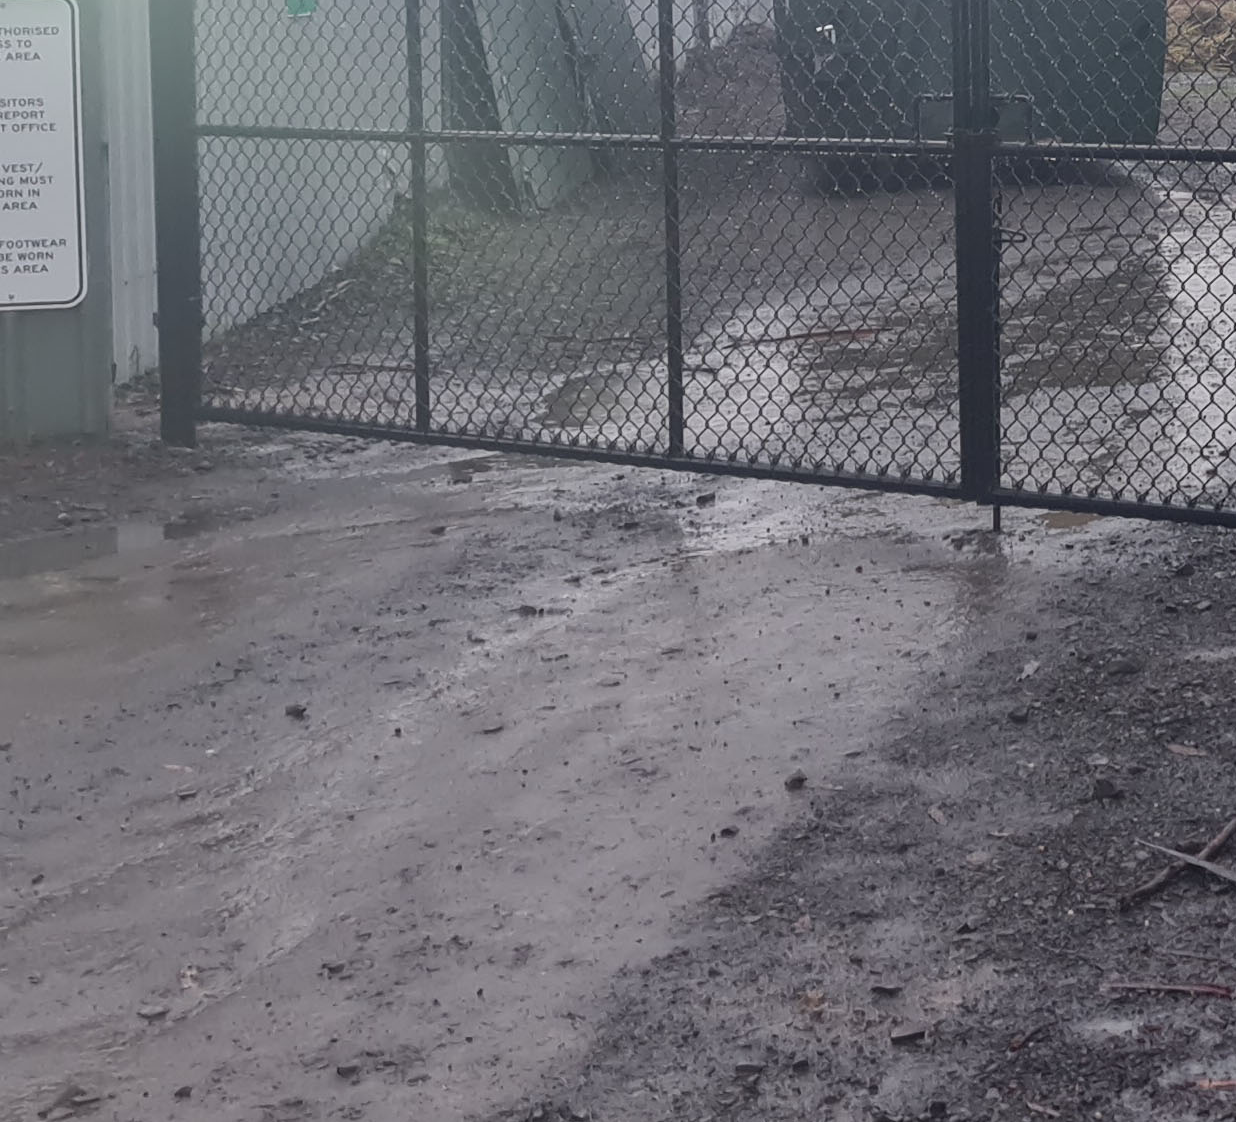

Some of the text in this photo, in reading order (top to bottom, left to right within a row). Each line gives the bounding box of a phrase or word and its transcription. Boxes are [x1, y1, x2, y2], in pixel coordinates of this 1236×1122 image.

[15, 39, 32, 48] TO
[5, 51, 41, 61] AREA
[12, 121, 56, 133] OFFICE
[1, 162, 43, 174] VEST/
[19, 175, 53, 185] MUST
[28, 188, 40, 197] IN
[2, 201, 38, 211] AREA
[17, 251, 54, 261] WORN
[13, 264, 49, 274] AREA
